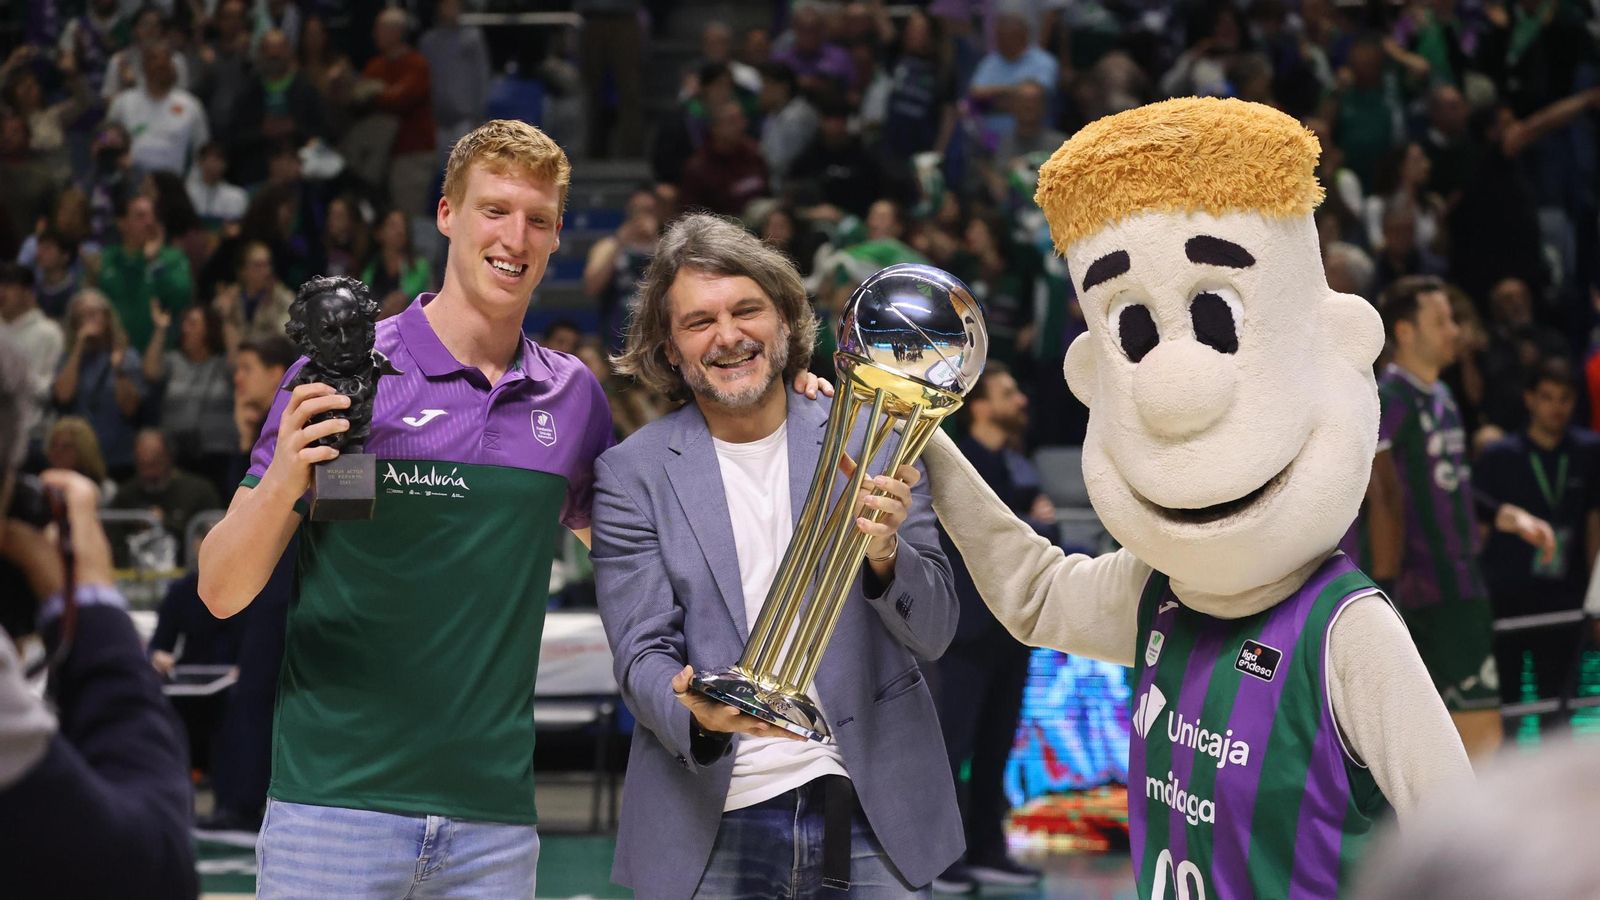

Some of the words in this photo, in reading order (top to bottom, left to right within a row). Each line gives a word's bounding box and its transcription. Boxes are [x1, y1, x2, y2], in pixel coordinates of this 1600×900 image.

[383, 462, 470, 490] Andalucía
[1241, 649, 1258, 661] liga
[1238, 659, 1272, 677] endesa
[1168, 710, 1250, 768] Unicaja
